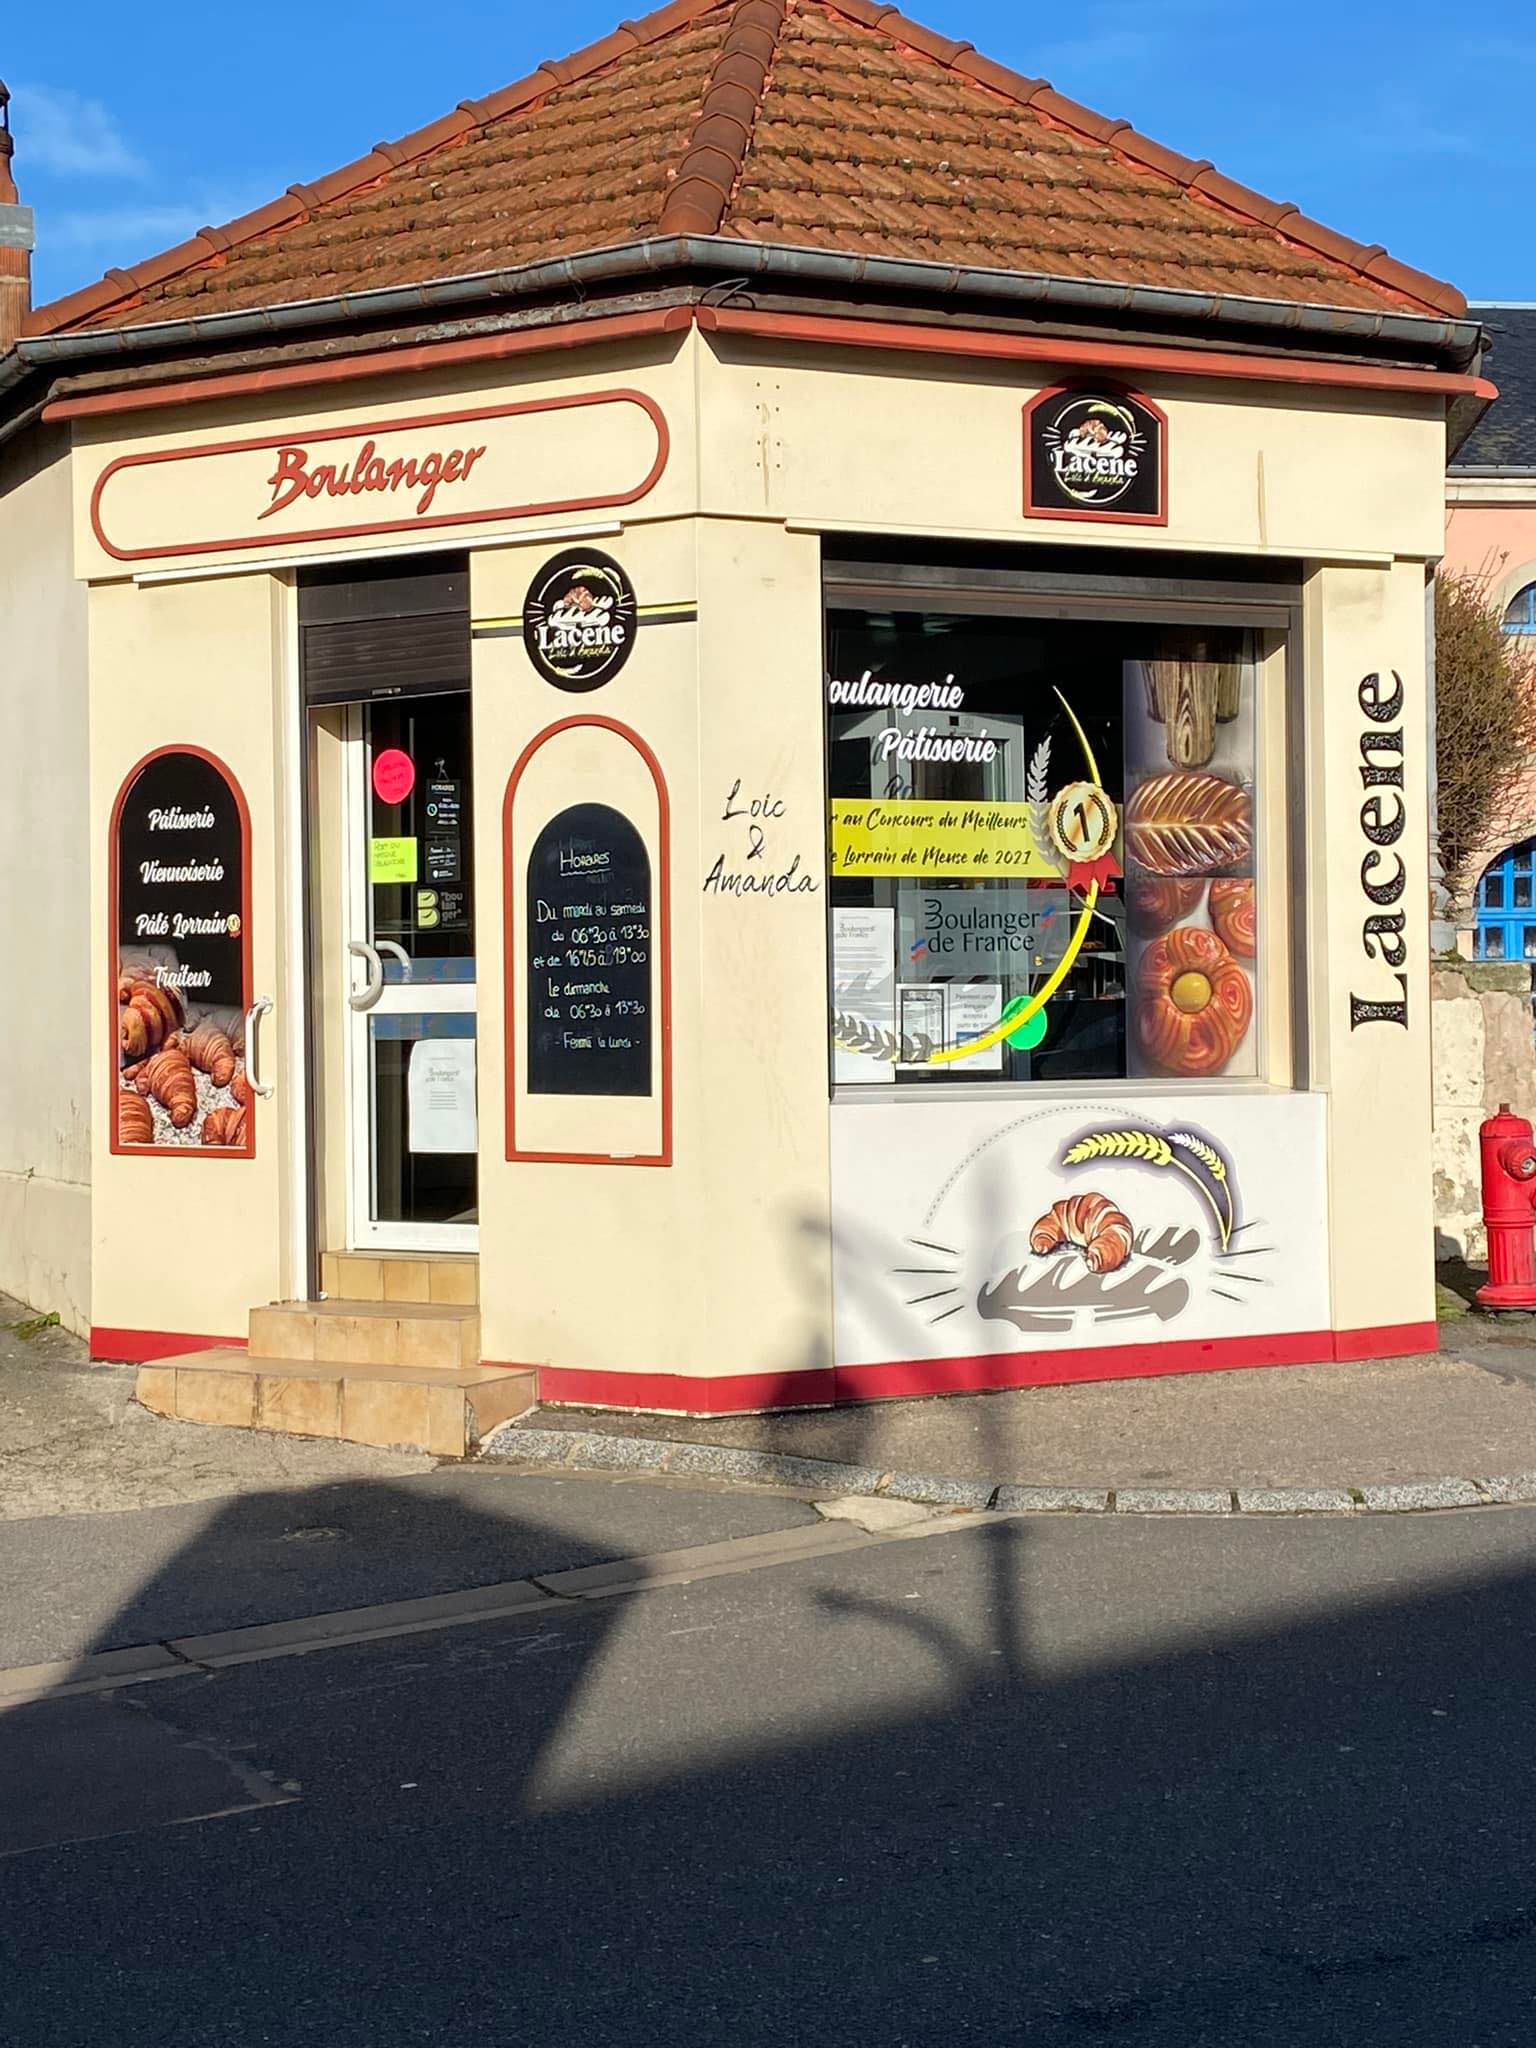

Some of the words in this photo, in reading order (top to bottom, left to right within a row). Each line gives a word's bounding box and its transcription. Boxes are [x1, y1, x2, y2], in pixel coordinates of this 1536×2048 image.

[1054, 450, 1138, 477] Lacene
[258, 441, 487, 520] Boulanger
[537, 624, 626, 650] Lacene
[828, 670, 964, 716] oulangerie
[879, 727, 997, 763] Pâtisserie
[843, 815, 863, 828] au
[866, 807, 934, 831] Concours
[938, 814, 958, 828] du
[961, 810, 1027, 830] Meilleurs
[1073, 802, 1090, 843] 1
[747, 824, 765, 860] &
[1350, 669, 1408, 1032] Lacene
[843, 845, 897, 868] Lorrain
[901, 848, 918, 864] de
[922, 848, 968, 867] Meuse
[973, 849, 989, 864] de
[995, 849, 1031, 865] 2021
[140, 858, 225, 884] Viennoiserie
[702, 853, 820, 898] Amanda
[136, 912, 169, 937] Pâté
[172, 911, 227, 939] Lorrain
[536, 899, 558, 923] Du
[924, 899, 1040, 934] Boulanger
[928, 933, 954, 953] de
[963, 932, 1034, 953] France
[153, 964, 212, 989] Traiteur
